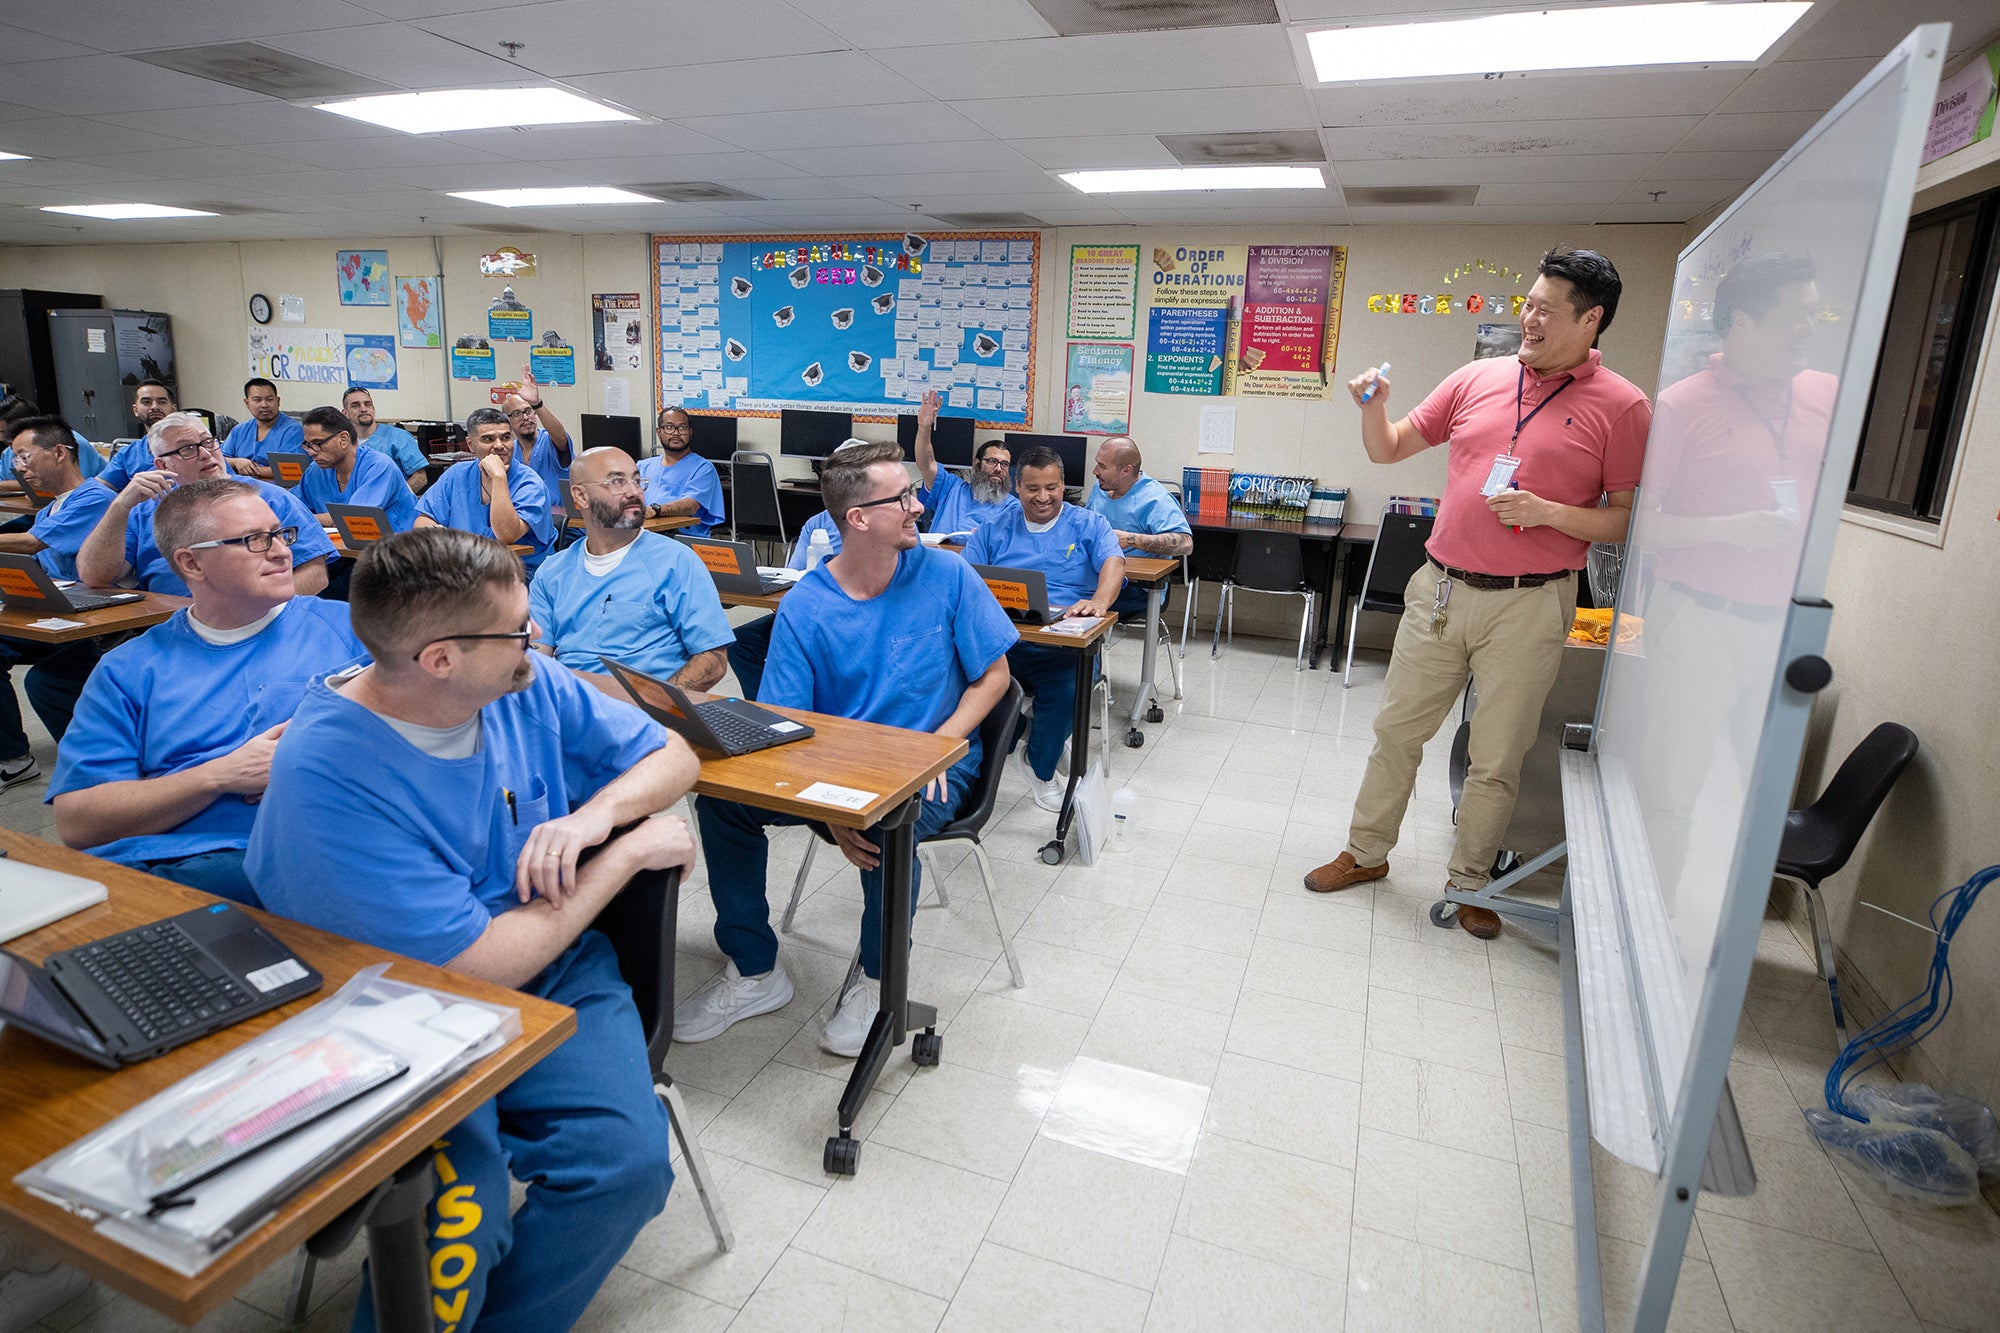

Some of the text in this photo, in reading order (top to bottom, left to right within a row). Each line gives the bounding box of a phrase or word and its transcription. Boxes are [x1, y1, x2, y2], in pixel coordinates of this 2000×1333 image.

[1934, 91, 1968, 117] Division
[752, 243, 922, 274] CONGRATULATIONS
[1176, 247, 1225, 262] ORDER
[1260, 248, 1330, 256] MULTIPLICATION
[1191, 262, 1208, 273] OF
[816, 267, 856, 285] GED
[1153, 271, 1245, 286] OPERATIONS
[1332, 251, 1344, 300] MY DEAR
[1154, 296, 1179, 304] simplify
[1200, 289, 1218, 297] steps
[594, 298, 640, 308] WE THE PEOPLE
[1255, 306, 1294, 314] ADDITION
[1367, 293, 1526, 316] CHECK-OUT
[1161, 310, 1218, 318] PARENTHESES
[1254, 316, 1313, 324] SUBTRACTION
[1230, 320, 1239, 353] PLEASE
[1076, 346, 1126, 356] Sentence
[1326, 332, 1337, 361] SALLY
[1080, 356, 1122, 366] Fluency
[1158, 355, 1204, 363] EXPONENTS
[260, 354, 291, 380] UCR
[298, 364, 345, 384] COHORT
[1226, 360, 1236, 393] EXCUSE
